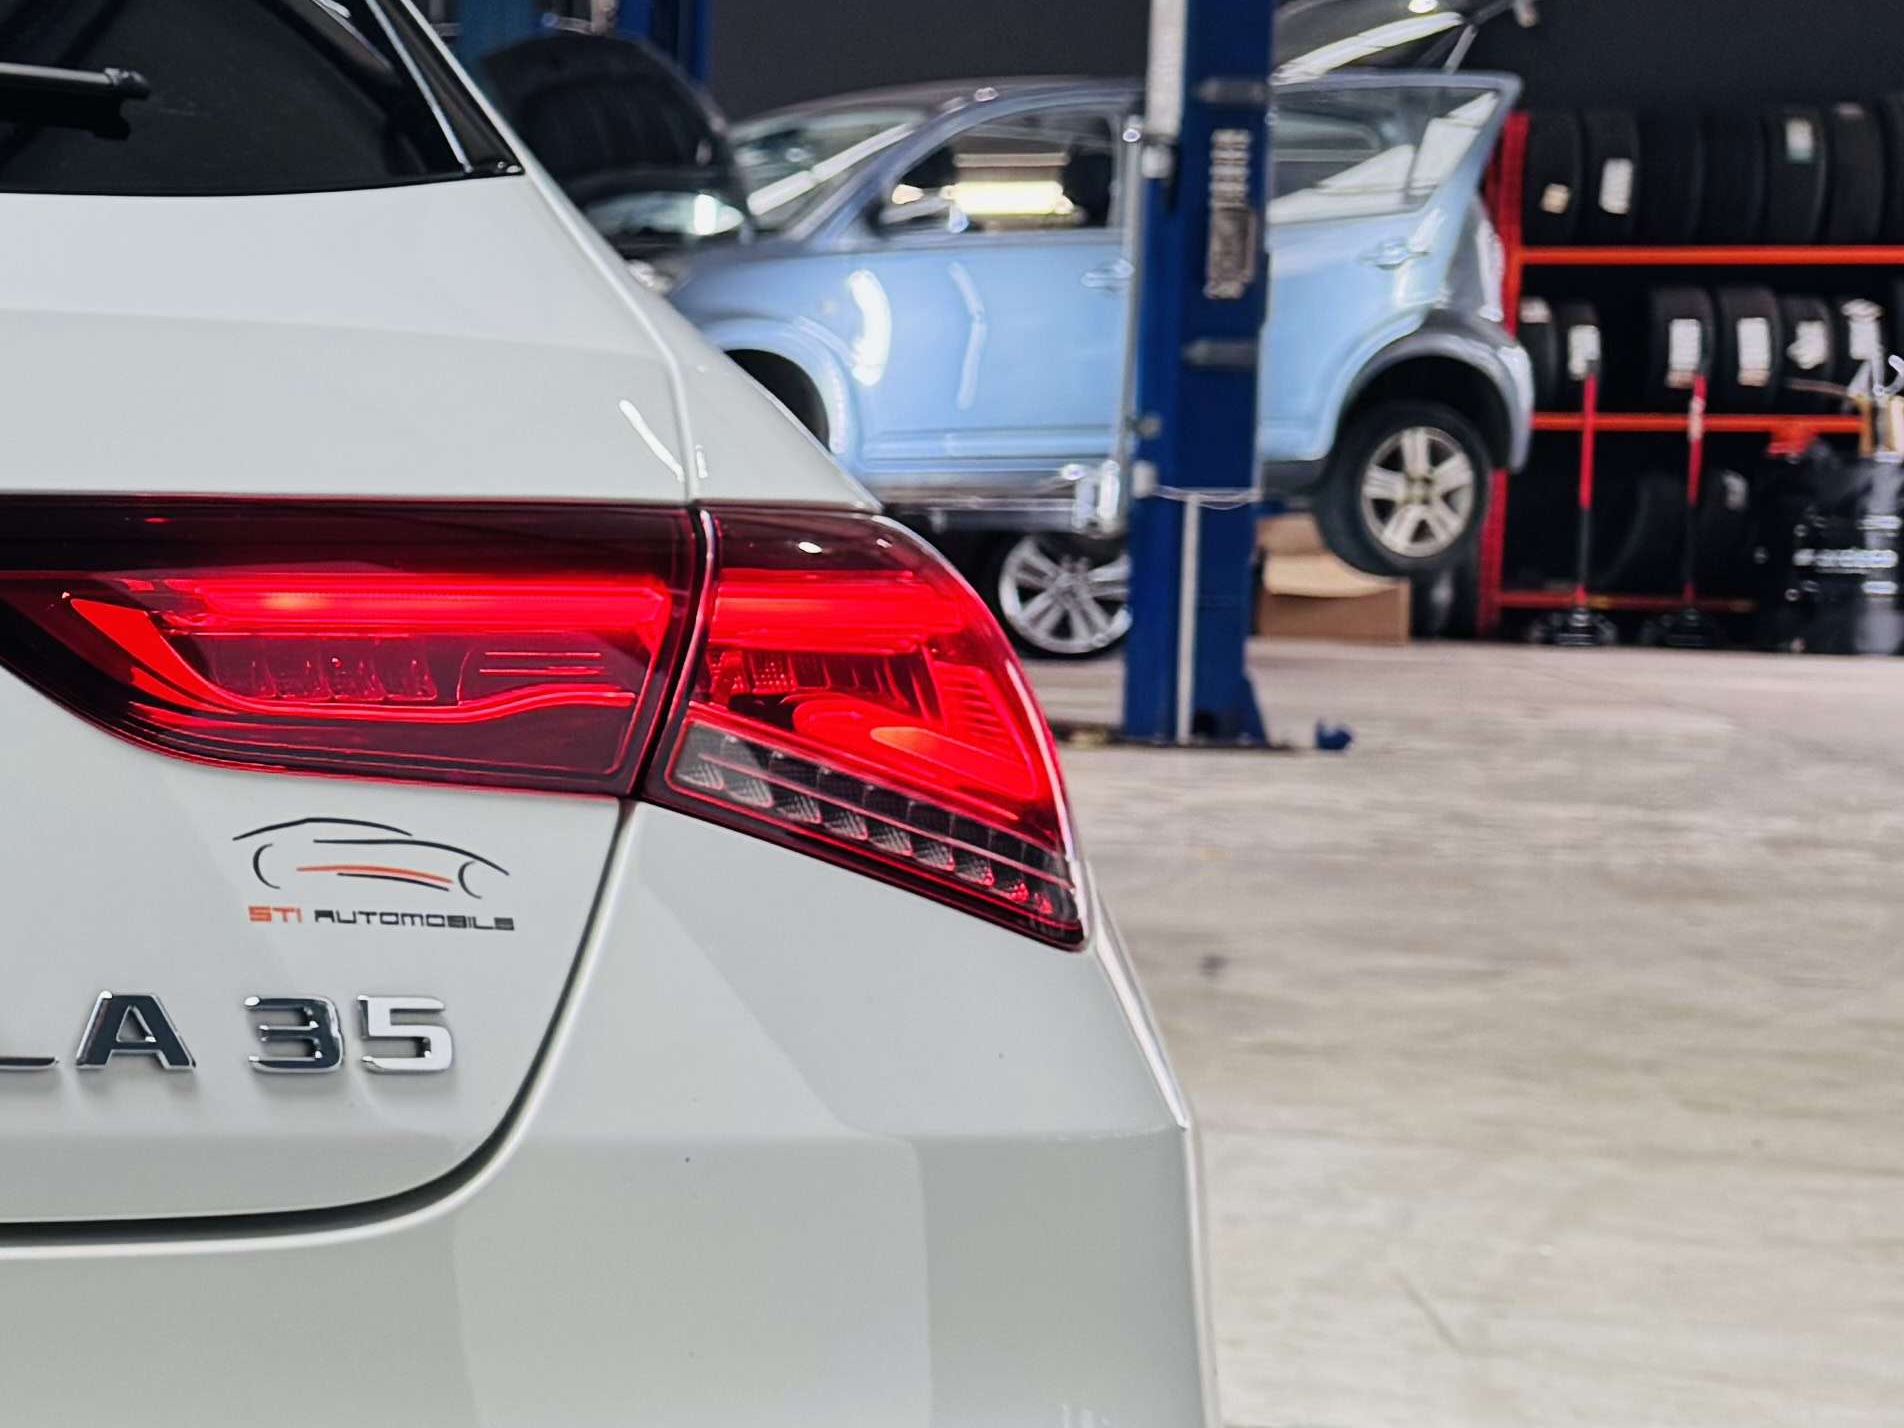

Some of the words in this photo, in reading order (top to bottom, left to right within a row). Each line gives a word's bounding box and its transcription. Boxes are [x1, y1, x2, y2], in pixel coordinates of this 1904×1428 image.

[248, 905, 303, 923] STI
[313, 909, 515, 931] AUTOMOBILE
[243, 994, 454, 1073] 35
